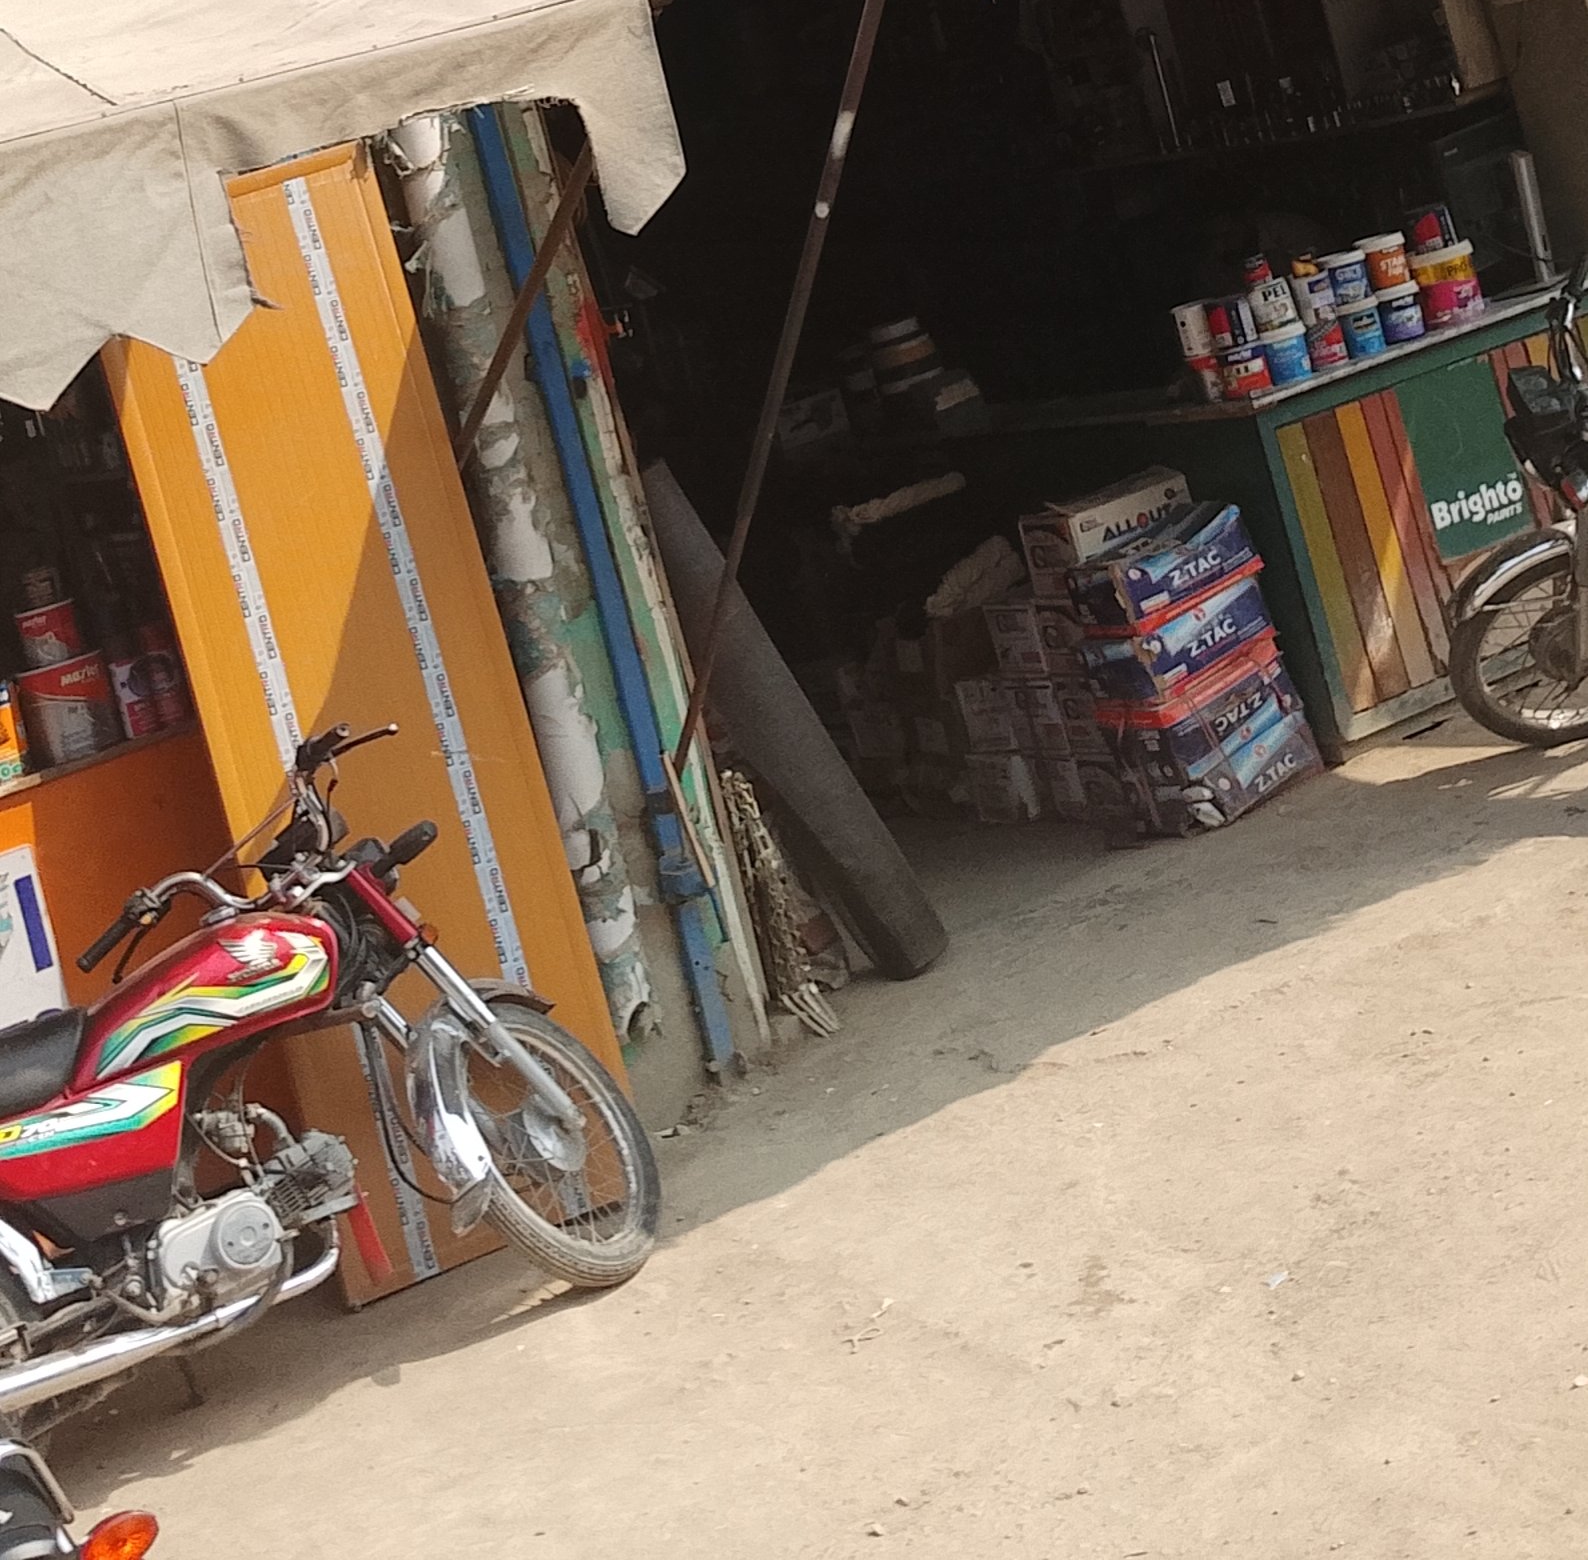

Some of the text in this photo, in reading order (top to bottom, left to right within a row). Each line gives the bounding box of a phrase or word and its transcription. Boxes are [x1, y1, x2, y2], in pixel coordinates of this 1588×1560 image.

[303, 208, 321, 250] CENTRO
[303, 253, 321, 296] CENTRO
[330, 299, 348, 342] CENTRO
[330, 345, 348, 388] CENTRO
[180, 383, 199, 427] CENTRO
[357, 391, 375, 433] CENTRO
[205, 423, 225, 467] CENTRO
[356, 438, 374, 481] CENTRO
[207, 478, 226, 522] CENTRO
[384, 483, 402, 527] CENTRO
[1486, 502, 1522, 525] PAINTS
[232, 519, 251, 563] CENTRO
[384, 531, 401, 575] CENTRO
[233, 574, 251, 618] CENTRO
[409, 577, 429, 621] CENTRO
[259, 615, 277, 660] CENTRO
[409, 626, 428, 670] CENTRO
[260, 671, 278, 717] CENTRO
[436, 673, 455, 718] CENTRO
[436, 722, 454, 767] CENTRO
[463, 770, 481, 815] CENTRO
[462, 820, 481, 865] CENTRO
[489, 868, 508, 913] CENTRO
[489, 919, 508, 964] CENTRO
[415, 1221, 435, 1270] CENTRO
